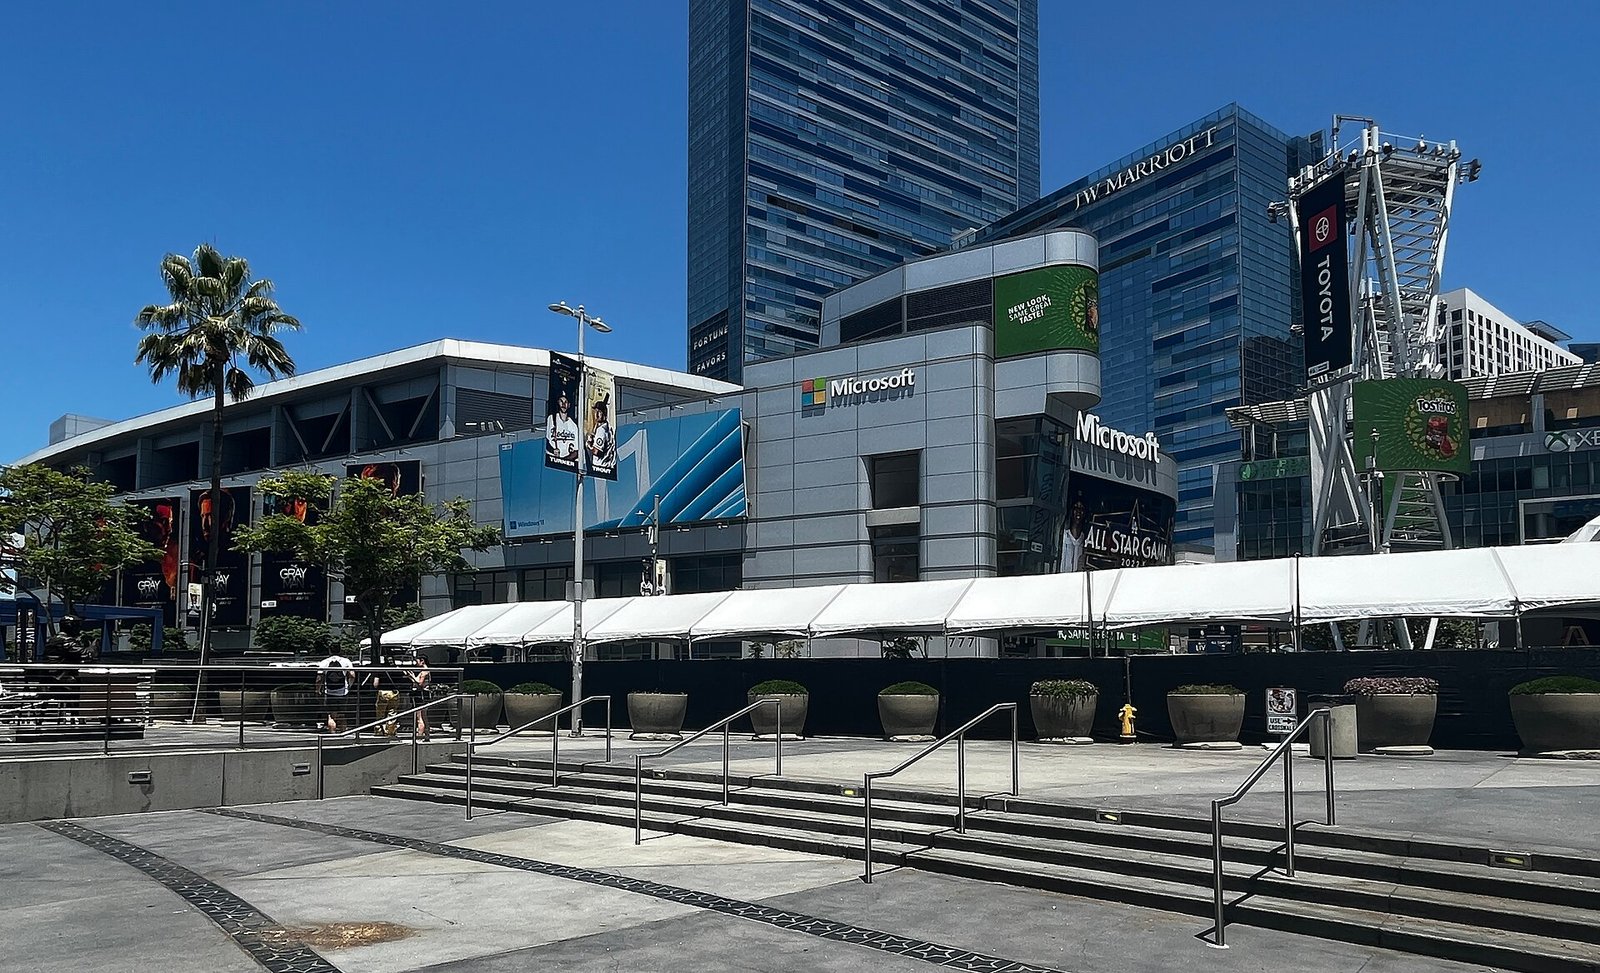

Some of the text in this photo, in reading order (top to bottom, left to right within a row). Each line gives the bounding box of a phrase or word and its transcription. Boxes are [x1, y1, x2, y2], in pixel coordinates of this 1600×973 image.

[1075, 126, 1217, 210] JW MARRIOTT
[1317, 254, 1334, 342] TOYOTA
[1008, 303, 1025, 315] NEW
[1009, 309, 1029, 322] SAME
[1019, 310, 1044, 324] TASTE!
[693, 325, 728, 351] FORTUNE
[696, 352, 726, 373] FAVORS
[831, 368, 916, 398] Microsoft
[1076, 410, 1160, 464] Microsoft
[568, 443, 575, 453] 6
[550, 456, 575, 467] TURNER
[591, 465, 612, 475] TROUT
[1083, 525, 1107, 552] ALL
[1110, 530, 1140, 557] STAR
[1121, 558, 1140, 568] 2022
[279, 567, 307, 580] GRAY
[137, 580, 161, 591] GRAY
[26, 627, 35, 643] LIVE
[949, 637, 974, 648] 777
